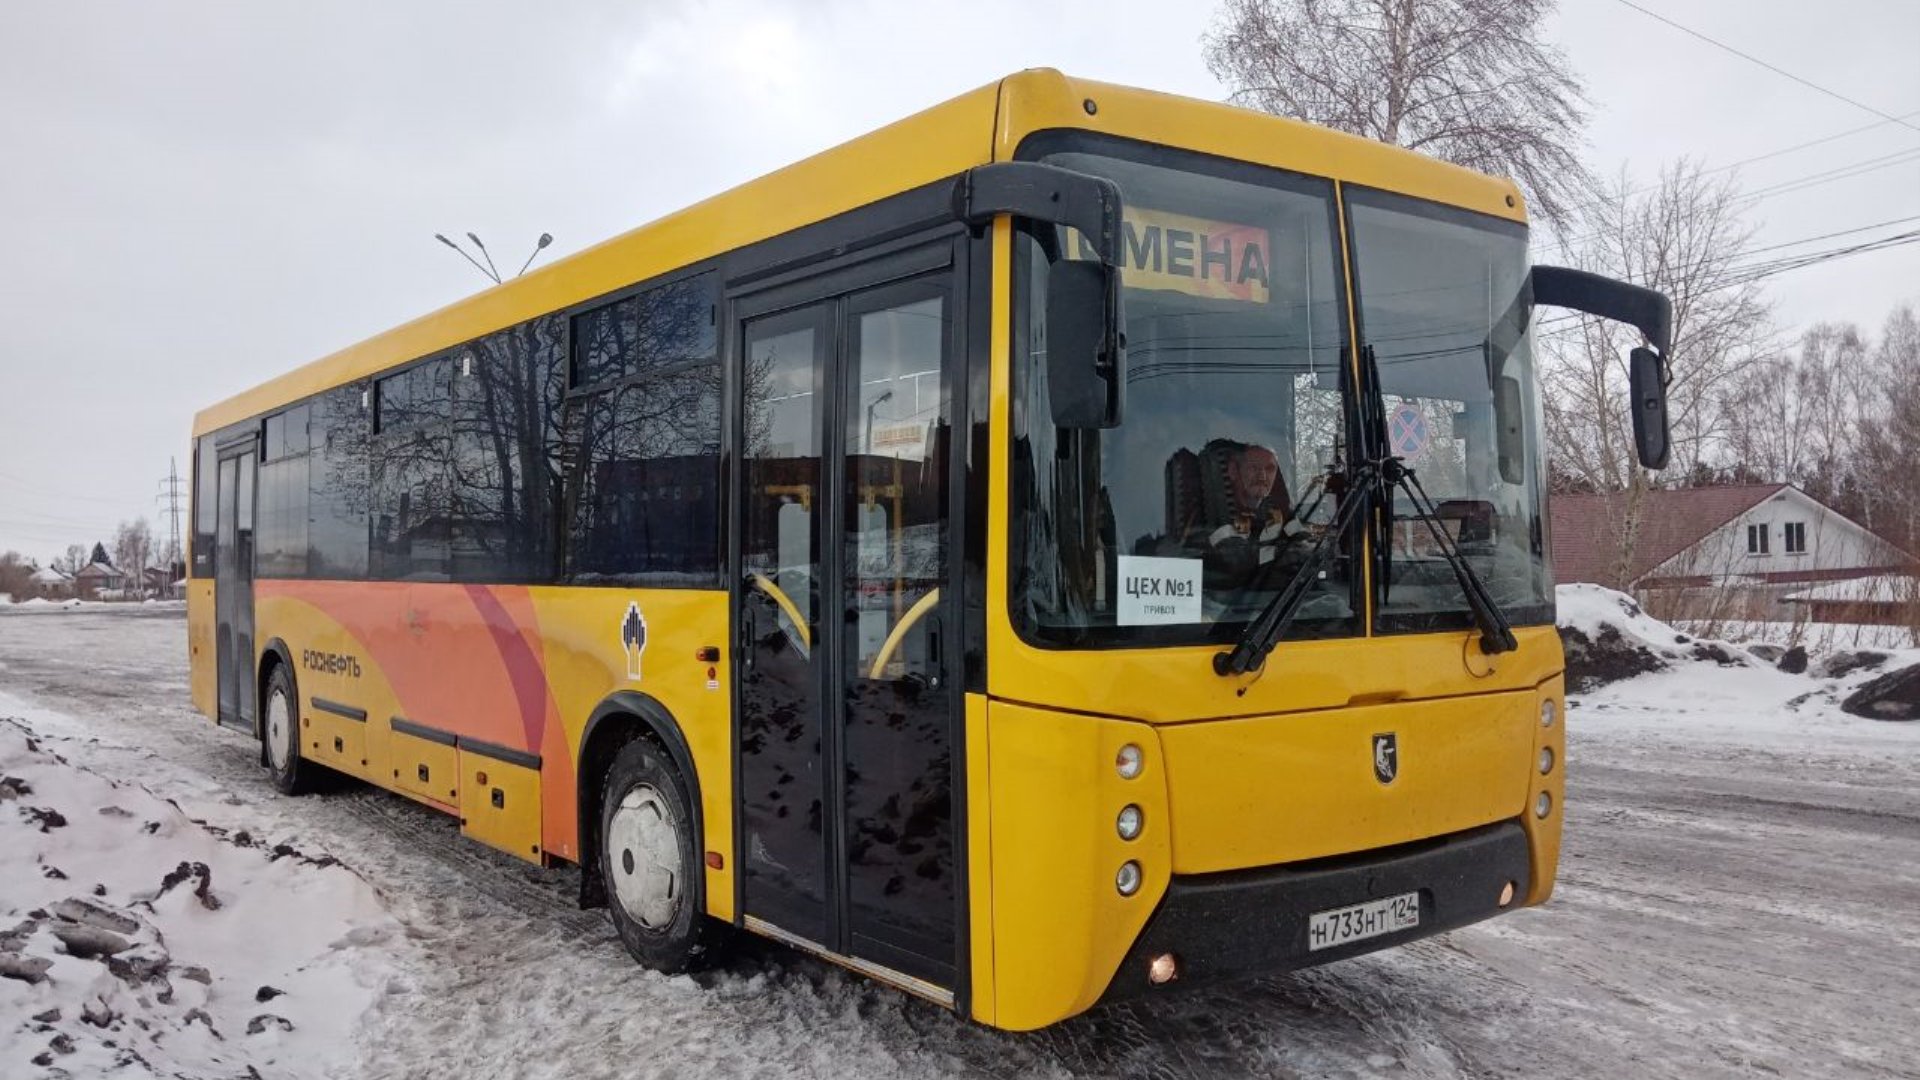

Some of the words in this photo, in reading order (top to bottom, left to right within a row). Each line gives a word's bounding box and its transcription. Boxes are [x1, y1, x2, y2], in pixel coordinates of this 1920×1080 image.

[1126, 577, 1160, 599] ЦЕХ
[1165, 578, 1194, 597] №1
[303, 649, 361, 678] РОСНЕФТЬ
